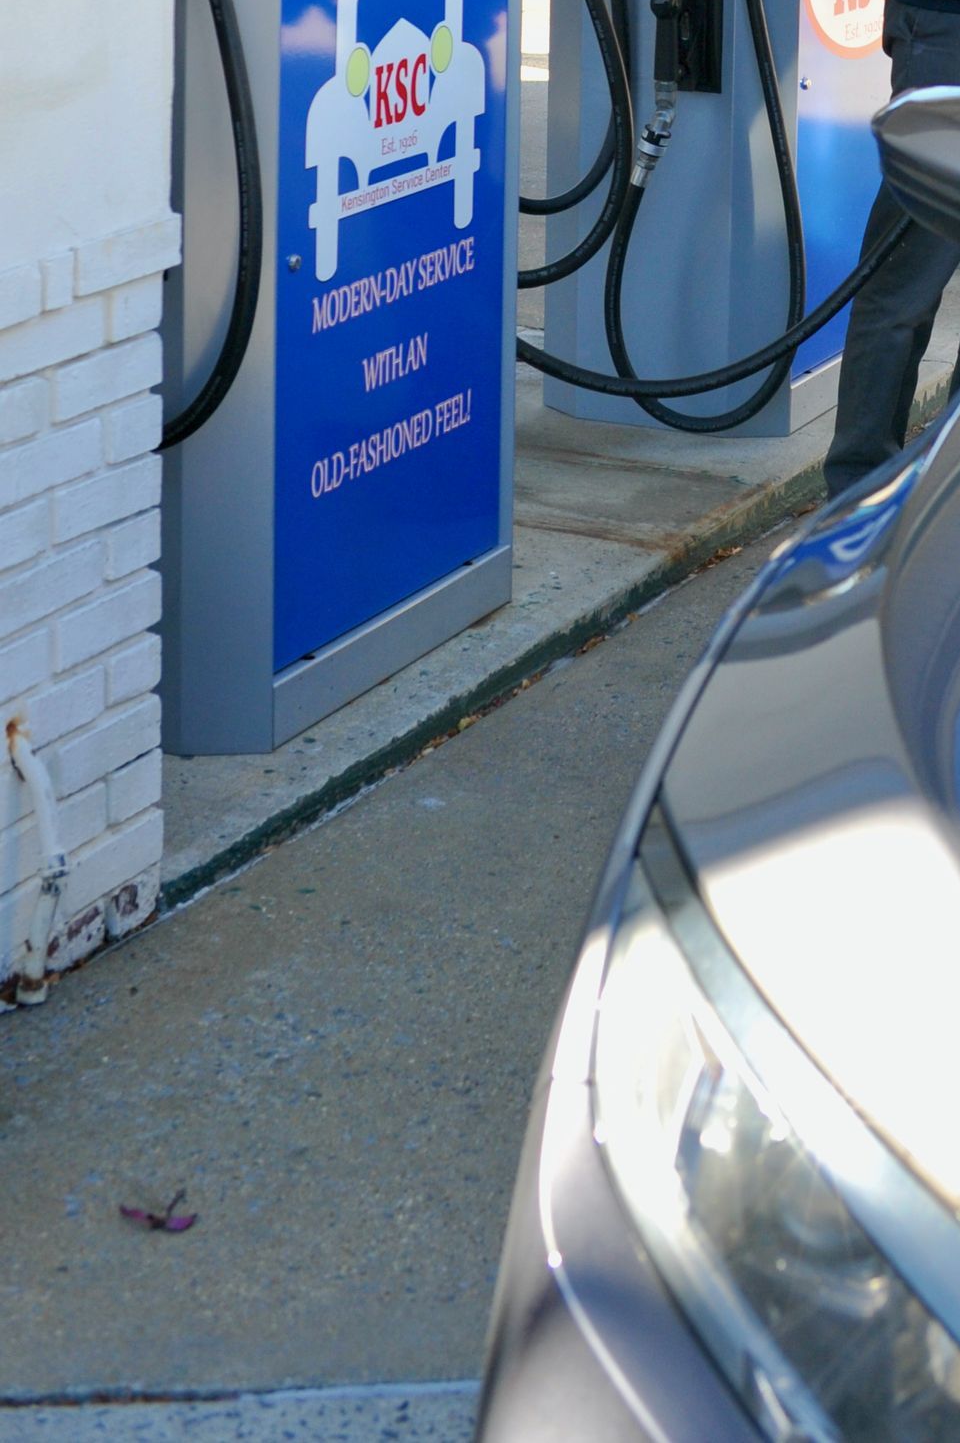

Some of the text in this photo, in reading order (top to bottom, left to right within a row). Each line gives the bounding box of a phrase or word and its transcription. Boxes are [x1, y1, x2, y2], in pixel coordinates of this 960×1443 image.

[374, 53, 427, 128] KSC
[381, 129, 418, 157] Est. 1926
[341, 163, 452, 213] Kensington Service Center
[311, 236, 475, 334] MODERN-DAY SERVICE
[362, 332, 428, 393] WITH AN
[311, 388, 472, 499] OLD-FASHIONED FEEL!
